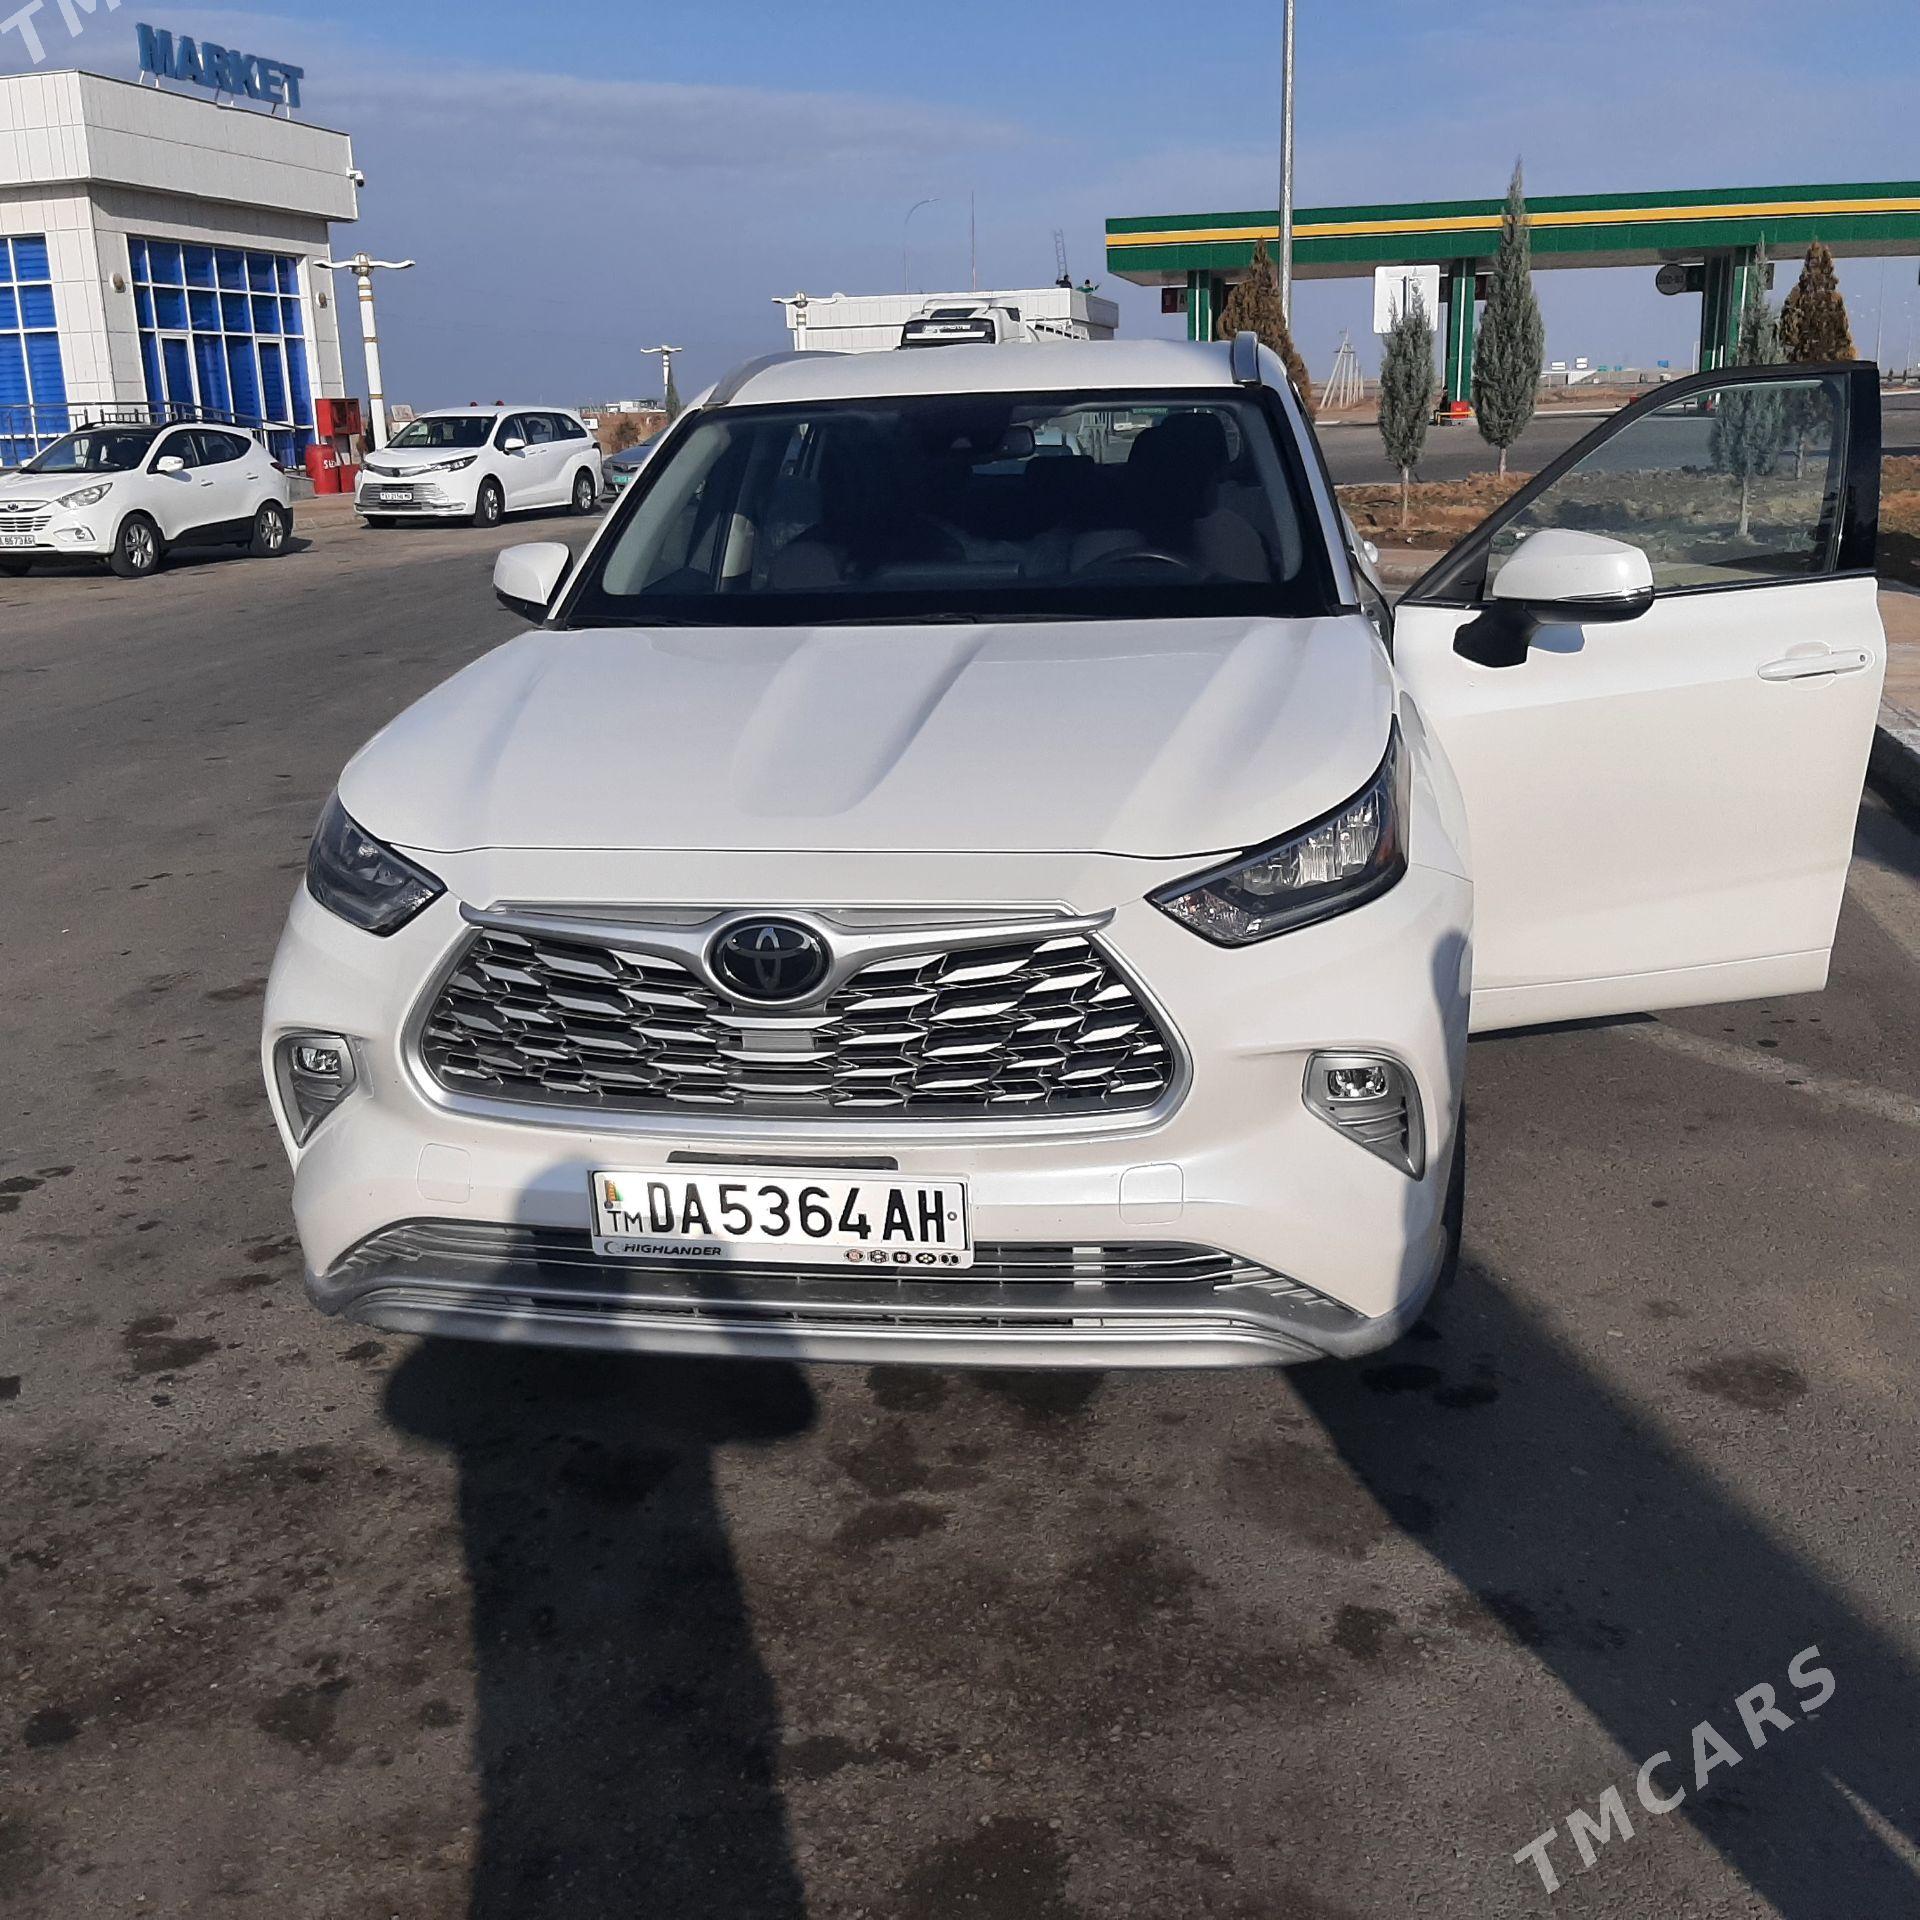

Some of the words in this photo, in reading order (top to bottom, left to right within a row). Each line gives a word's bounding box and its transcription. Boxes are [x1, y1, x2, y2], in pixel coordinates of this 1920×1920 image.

[135, 22, 305, 109] MARKET
[607, 1210, 644, 1233] TM
[646, 1181, 946, 1243] DA5364AH
[623, 1243, 722, 1256] HIGHLANDER
